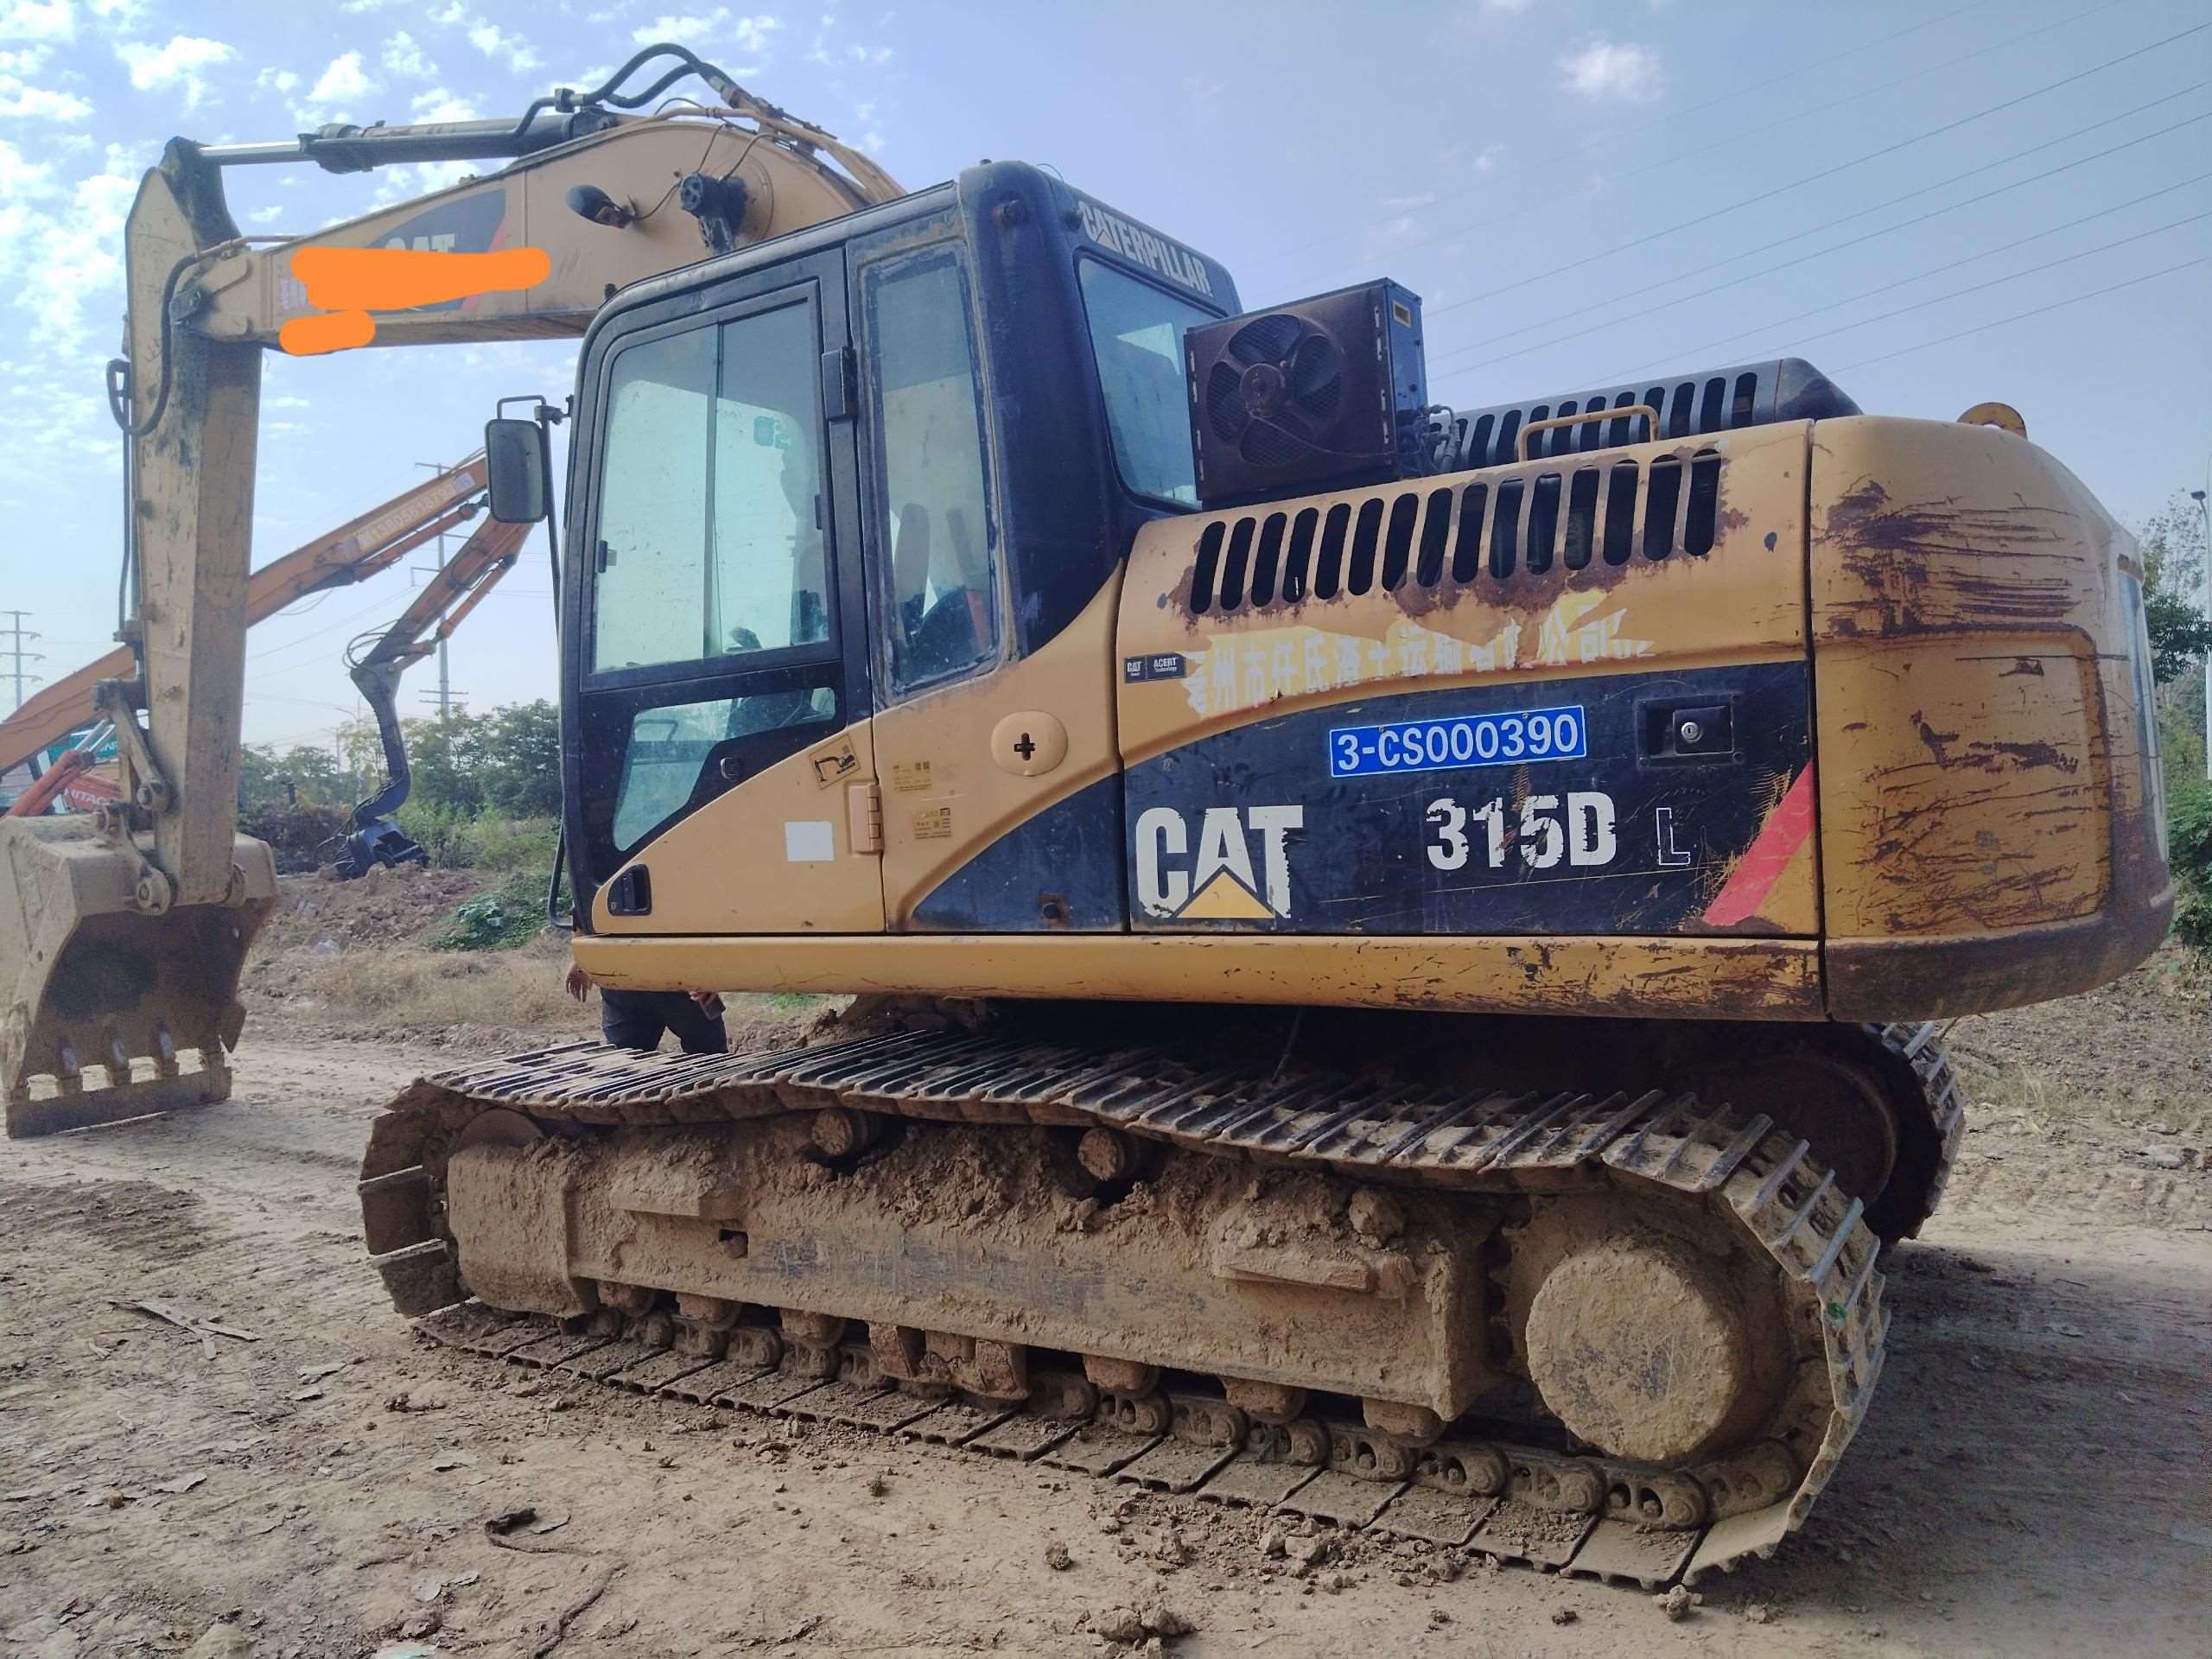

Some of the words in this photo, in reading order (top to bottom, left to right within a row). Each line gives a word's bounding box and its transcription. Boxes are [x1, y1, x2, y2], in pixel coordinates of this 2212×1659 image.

[1078, 200, 1213, 297] CATERPILLAR
[1127, 661, 1141, 672] CAT
[1154, 657, 1178, 669] ACERT
[1338, 713, 1579, 772] 3-CS000390
[1135, 805, 1304, 918] CAT
[1427, 792, 1616, 868] 315D
[1656, 807, 1691, 867] L
